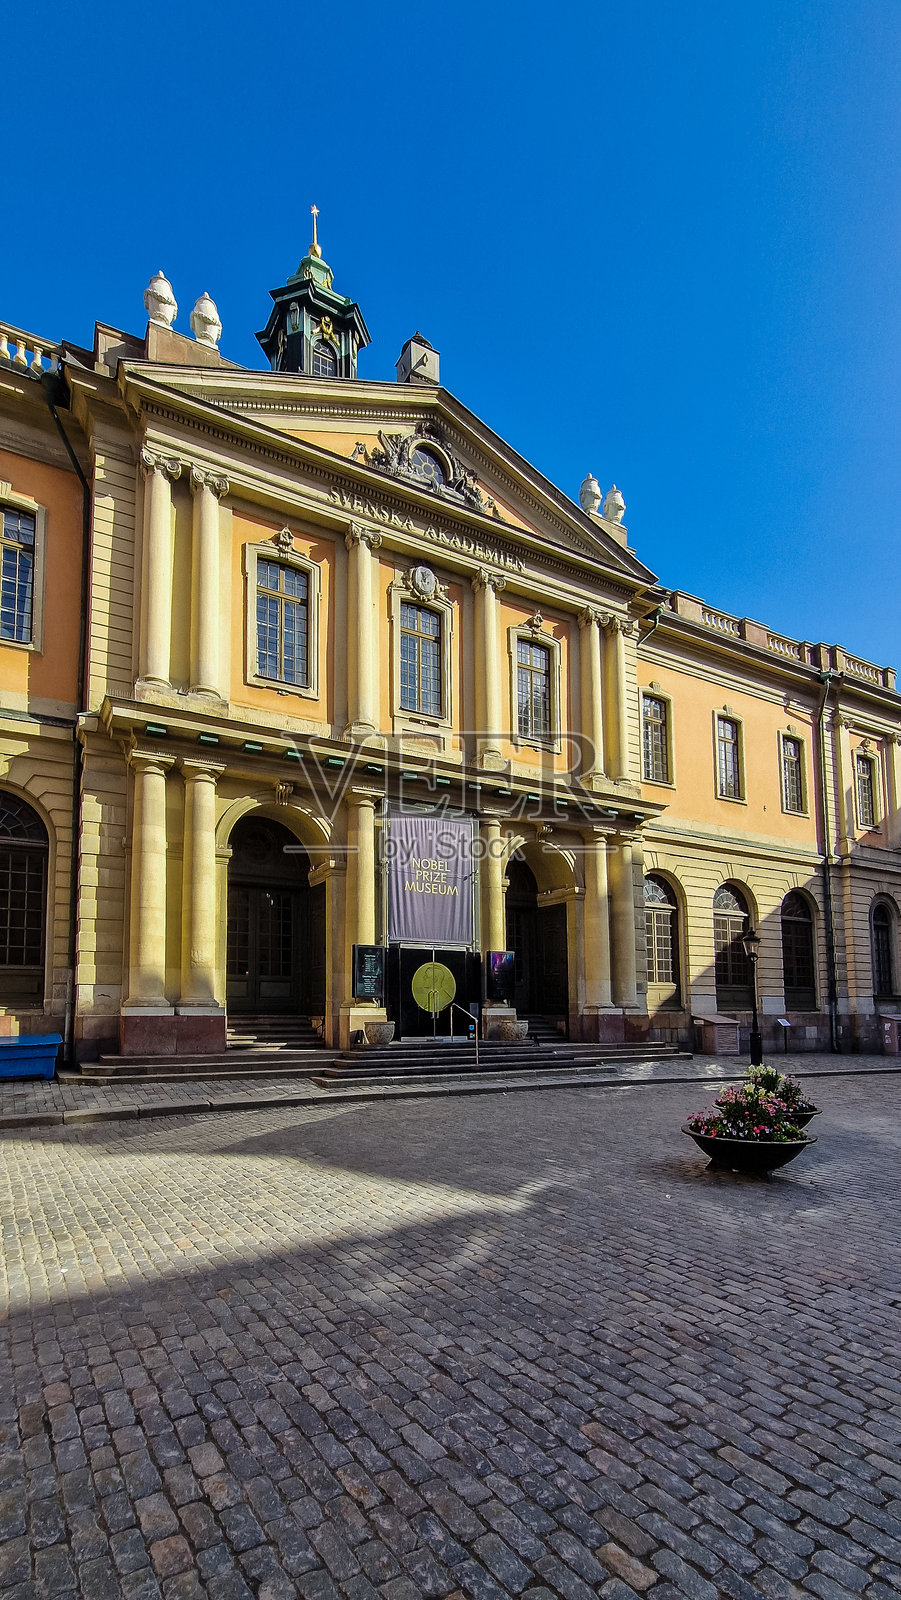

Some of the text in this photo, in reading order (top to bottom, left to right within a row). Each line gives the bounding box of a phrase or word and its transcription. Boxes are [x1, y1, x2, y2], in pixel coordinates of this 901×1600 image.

[326, 485, 527, 572] SVENSKA AKADEMIEN
[412, 857, 451, 872] NOBEL
[415, 870, 448, 883] PRIZE
[404, 880, 459, 897] MUSEUM
